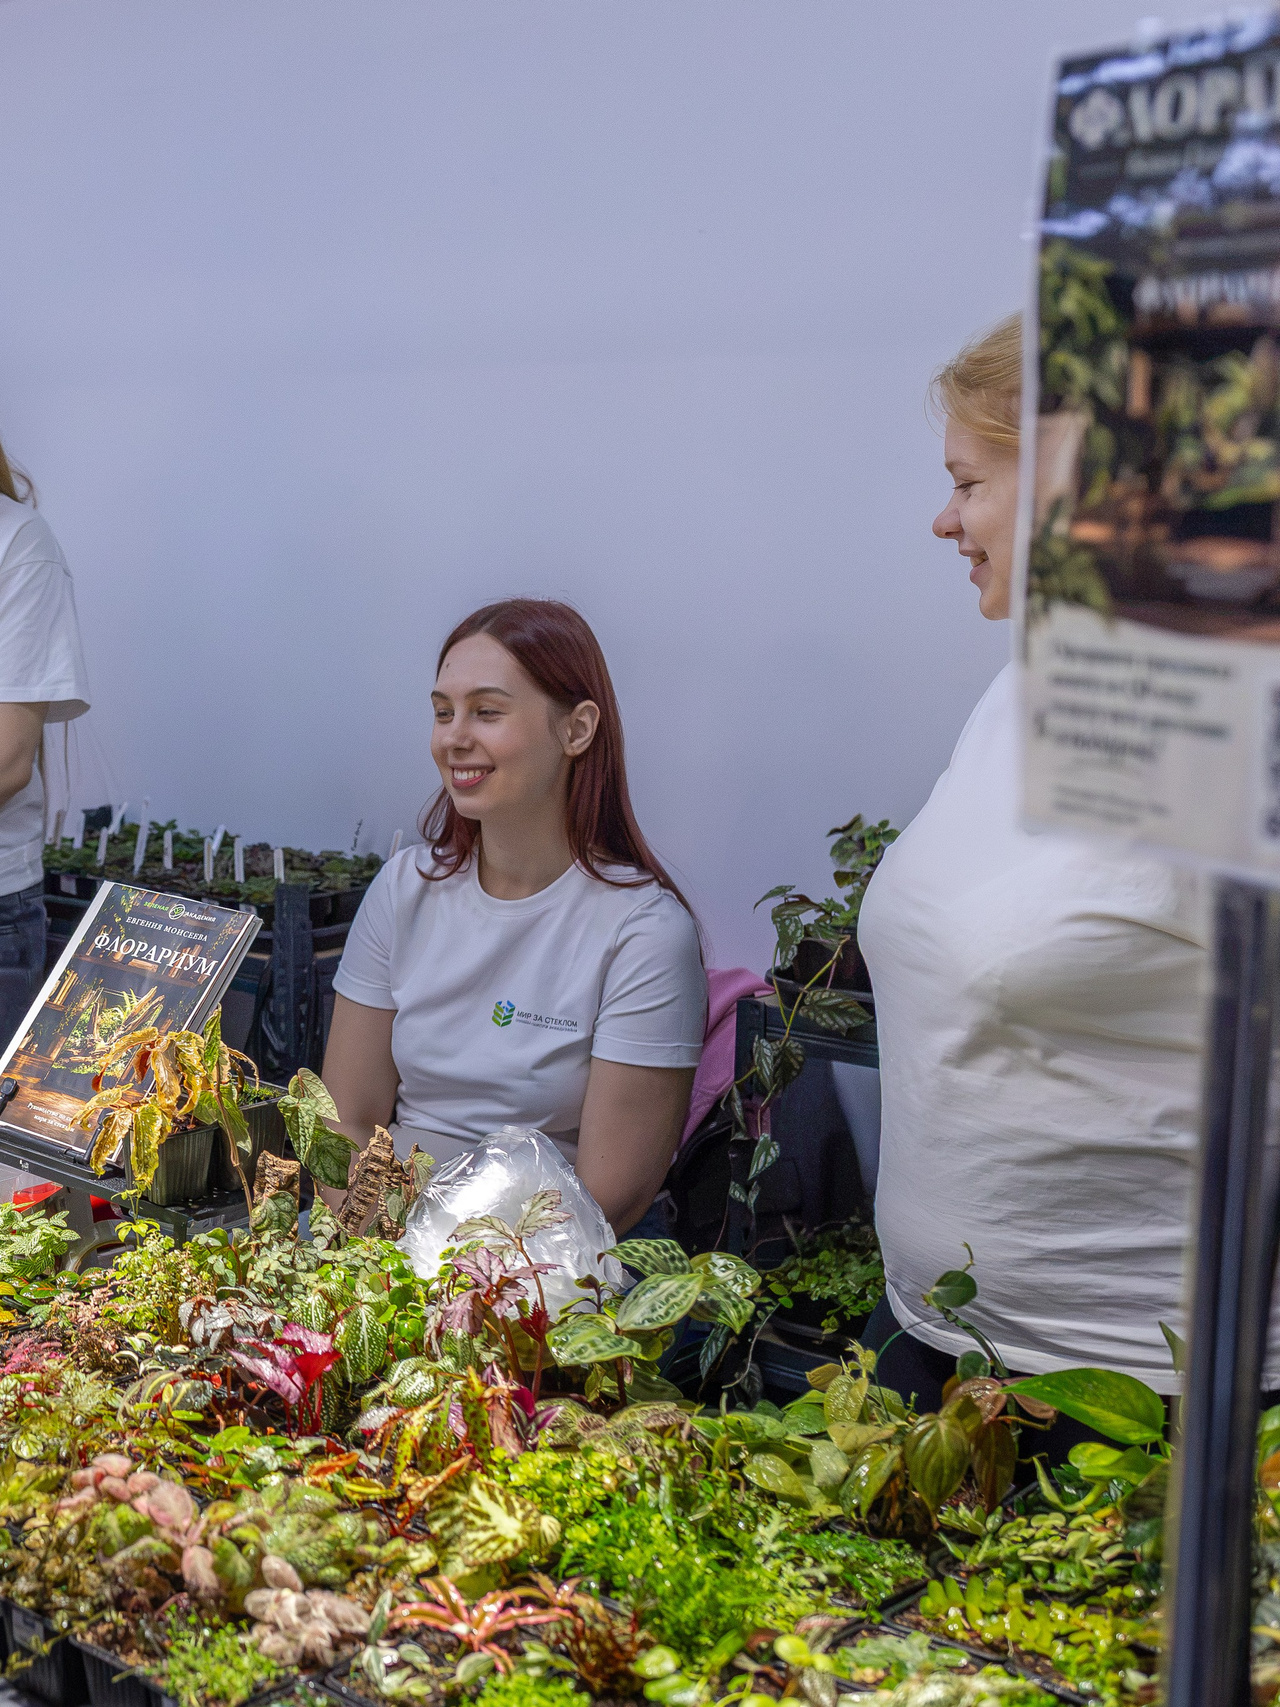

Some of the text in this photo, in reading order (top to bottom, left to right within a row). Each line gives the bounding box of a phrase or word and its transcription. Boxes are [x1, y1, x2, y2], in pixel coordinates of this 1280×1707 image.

[184, 911, 217, 922] АКАДЕМИЯ
[125, 916, 208, 942] ЕВГЕНИЯ МОИСЕЕВА
[94, 932, 219, 976] ФЛОРАРИУМ
[516, 1011, 532, 1019] МИР
[533, 1014, 543, 1022] ЗА
[544, 1016, 578, 1028] СТЕКЛОМ
